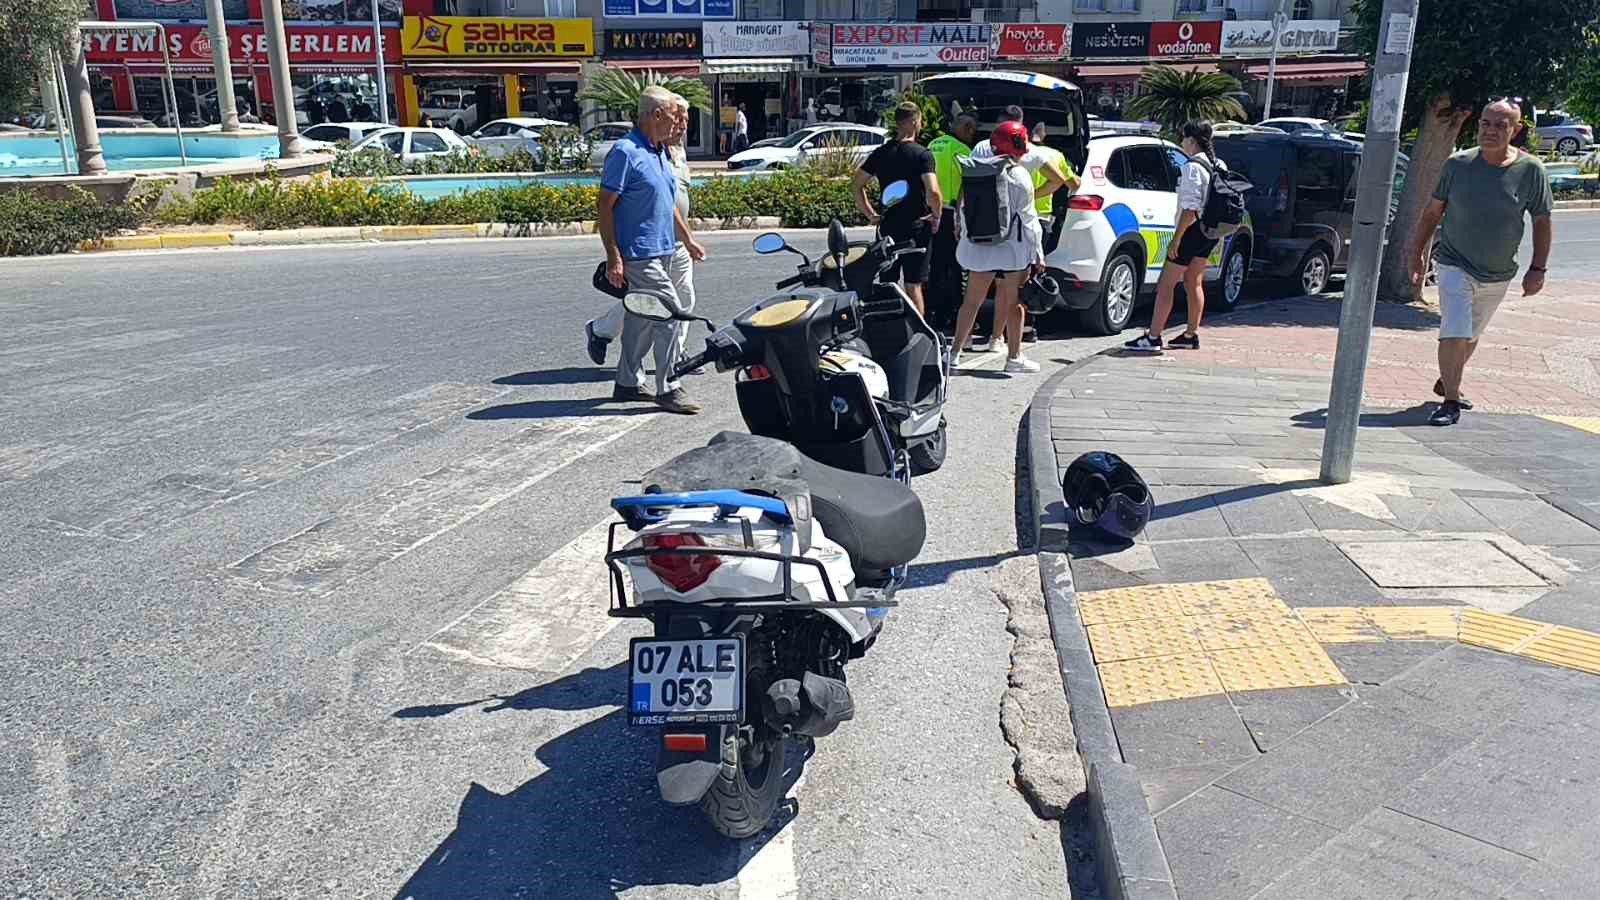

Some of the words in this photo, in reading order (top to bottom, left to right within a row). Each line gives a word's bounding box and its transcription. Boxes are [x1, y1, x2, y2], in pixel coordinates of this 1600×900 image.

[736, 24, 783, 35] MANAVGAT
[834, 25, 925, 44] EXPORT
[929, 25, 988, 43] MALL
[240, 34, 386, 57] ŞEERLEME
[612, 32, 697, 48] KUYUMCU
[1025, 40, 1057, 53] butik
[942, 48, 986, 61] Outlet
[1157, 41, 1211, 54] vodafone
[638, 646, 672, 674] 07
[677, 644, 735, 672] ALE
[661, 678, 713, 706] 053
[637, 701, 649, 711] TR
